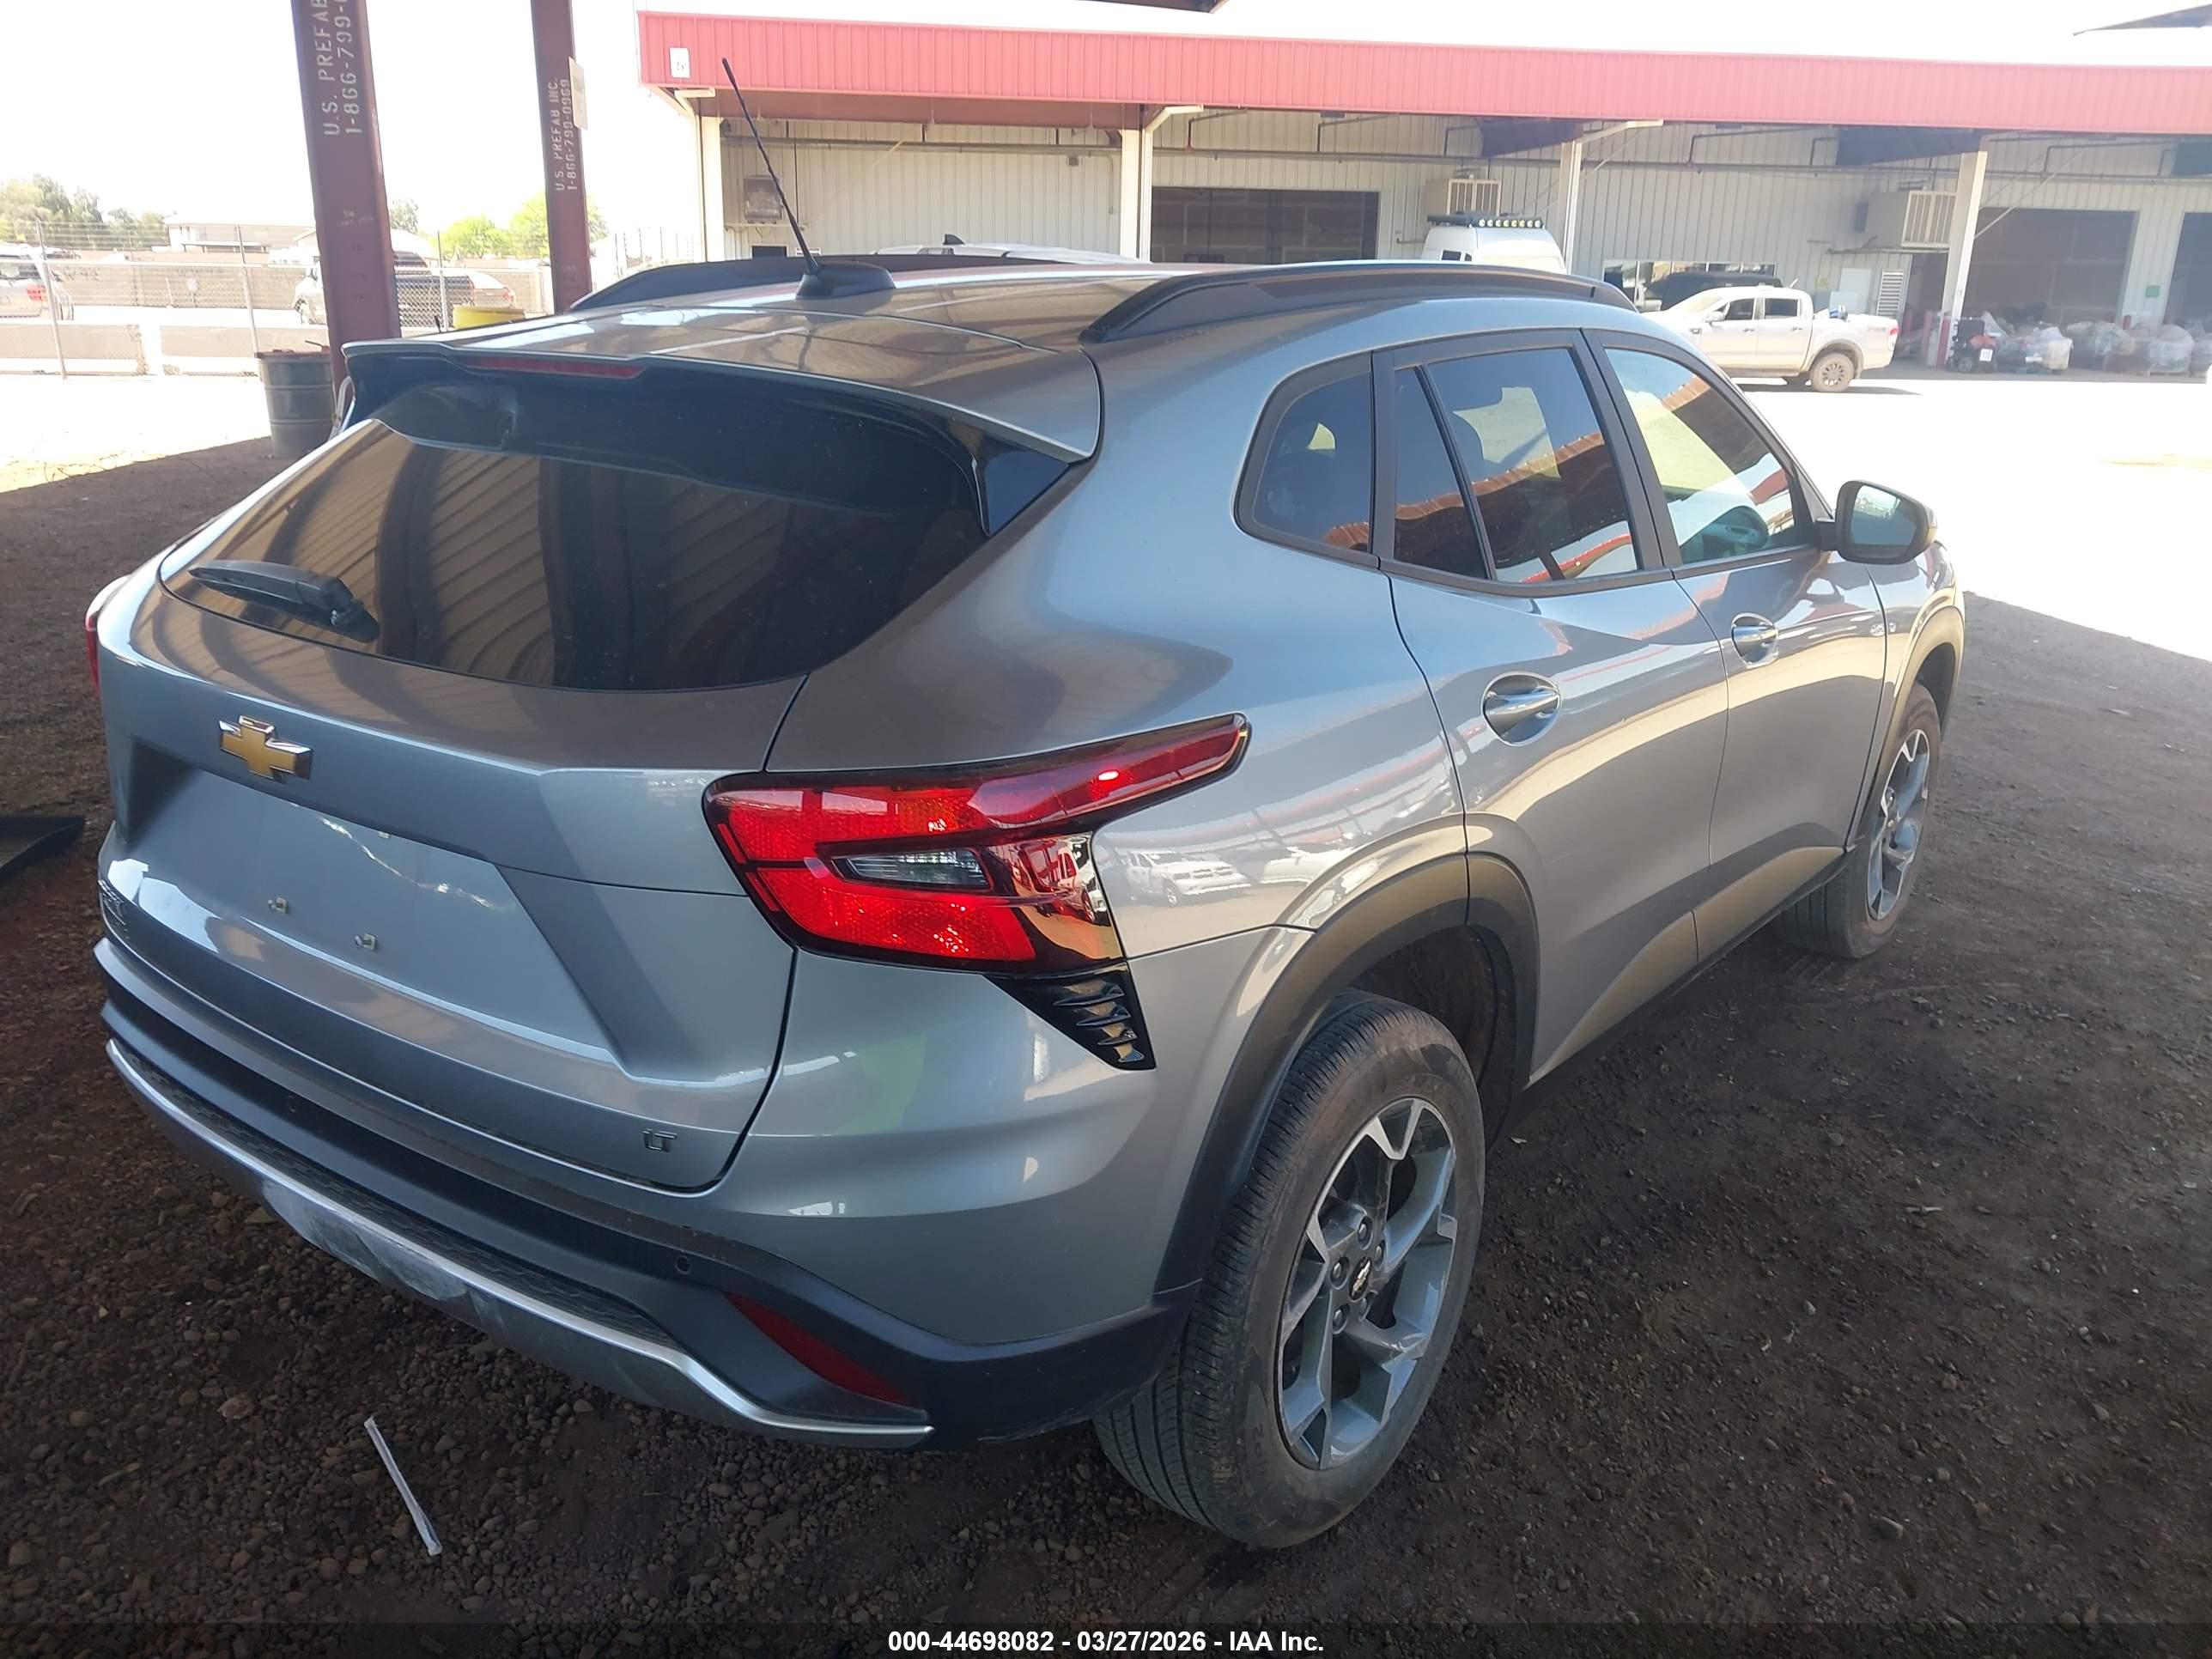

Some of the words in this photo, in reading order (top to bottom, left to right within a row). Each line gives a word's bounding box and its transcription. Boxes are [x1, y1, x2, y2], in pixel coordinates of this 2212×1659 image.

[333, 0, 362, 134] 1-866-799-
[321, 94, 340, 136] U.S.
[550, 109, 563, 160] PREFAB
[641, 1127, 678, 1153] LT
